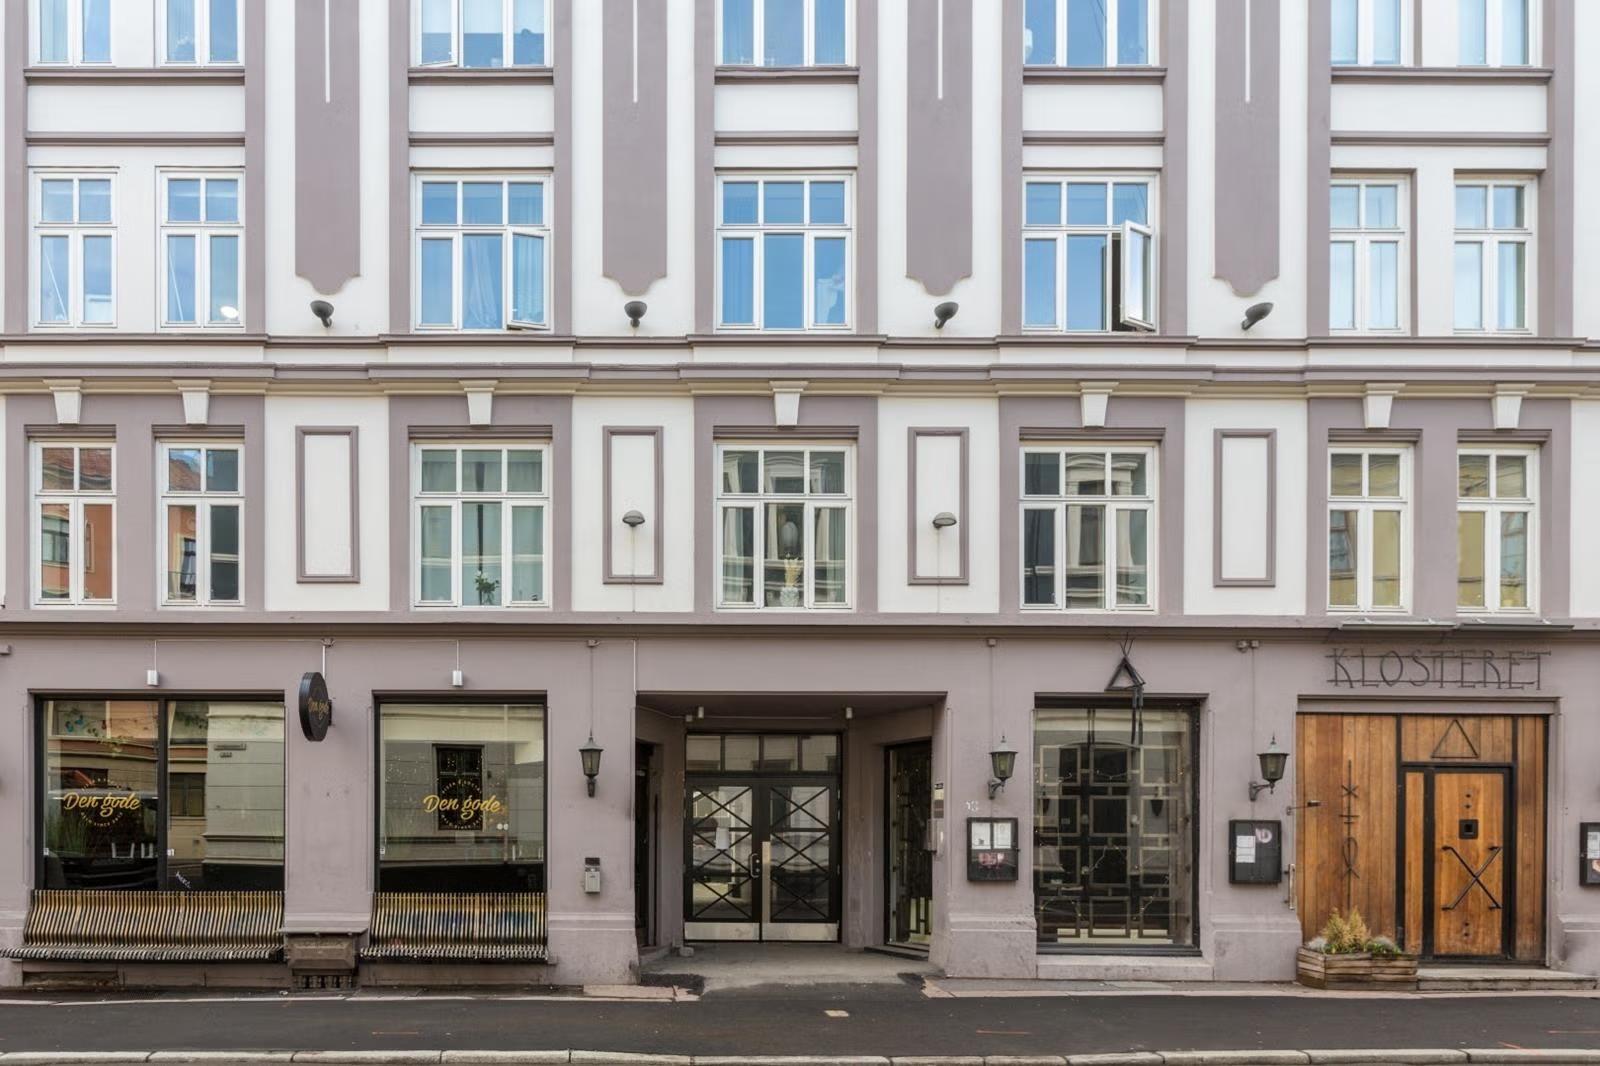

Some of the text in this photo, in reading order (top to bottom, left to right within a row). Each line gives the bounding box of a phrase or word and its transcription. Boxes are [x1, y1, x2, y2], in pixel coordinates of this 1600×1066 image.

[1330, 648, 1551, 690] KLOSTERET
[63, 792, 140, 817] Den gode
[423, 795, 501, 820] Den gode
